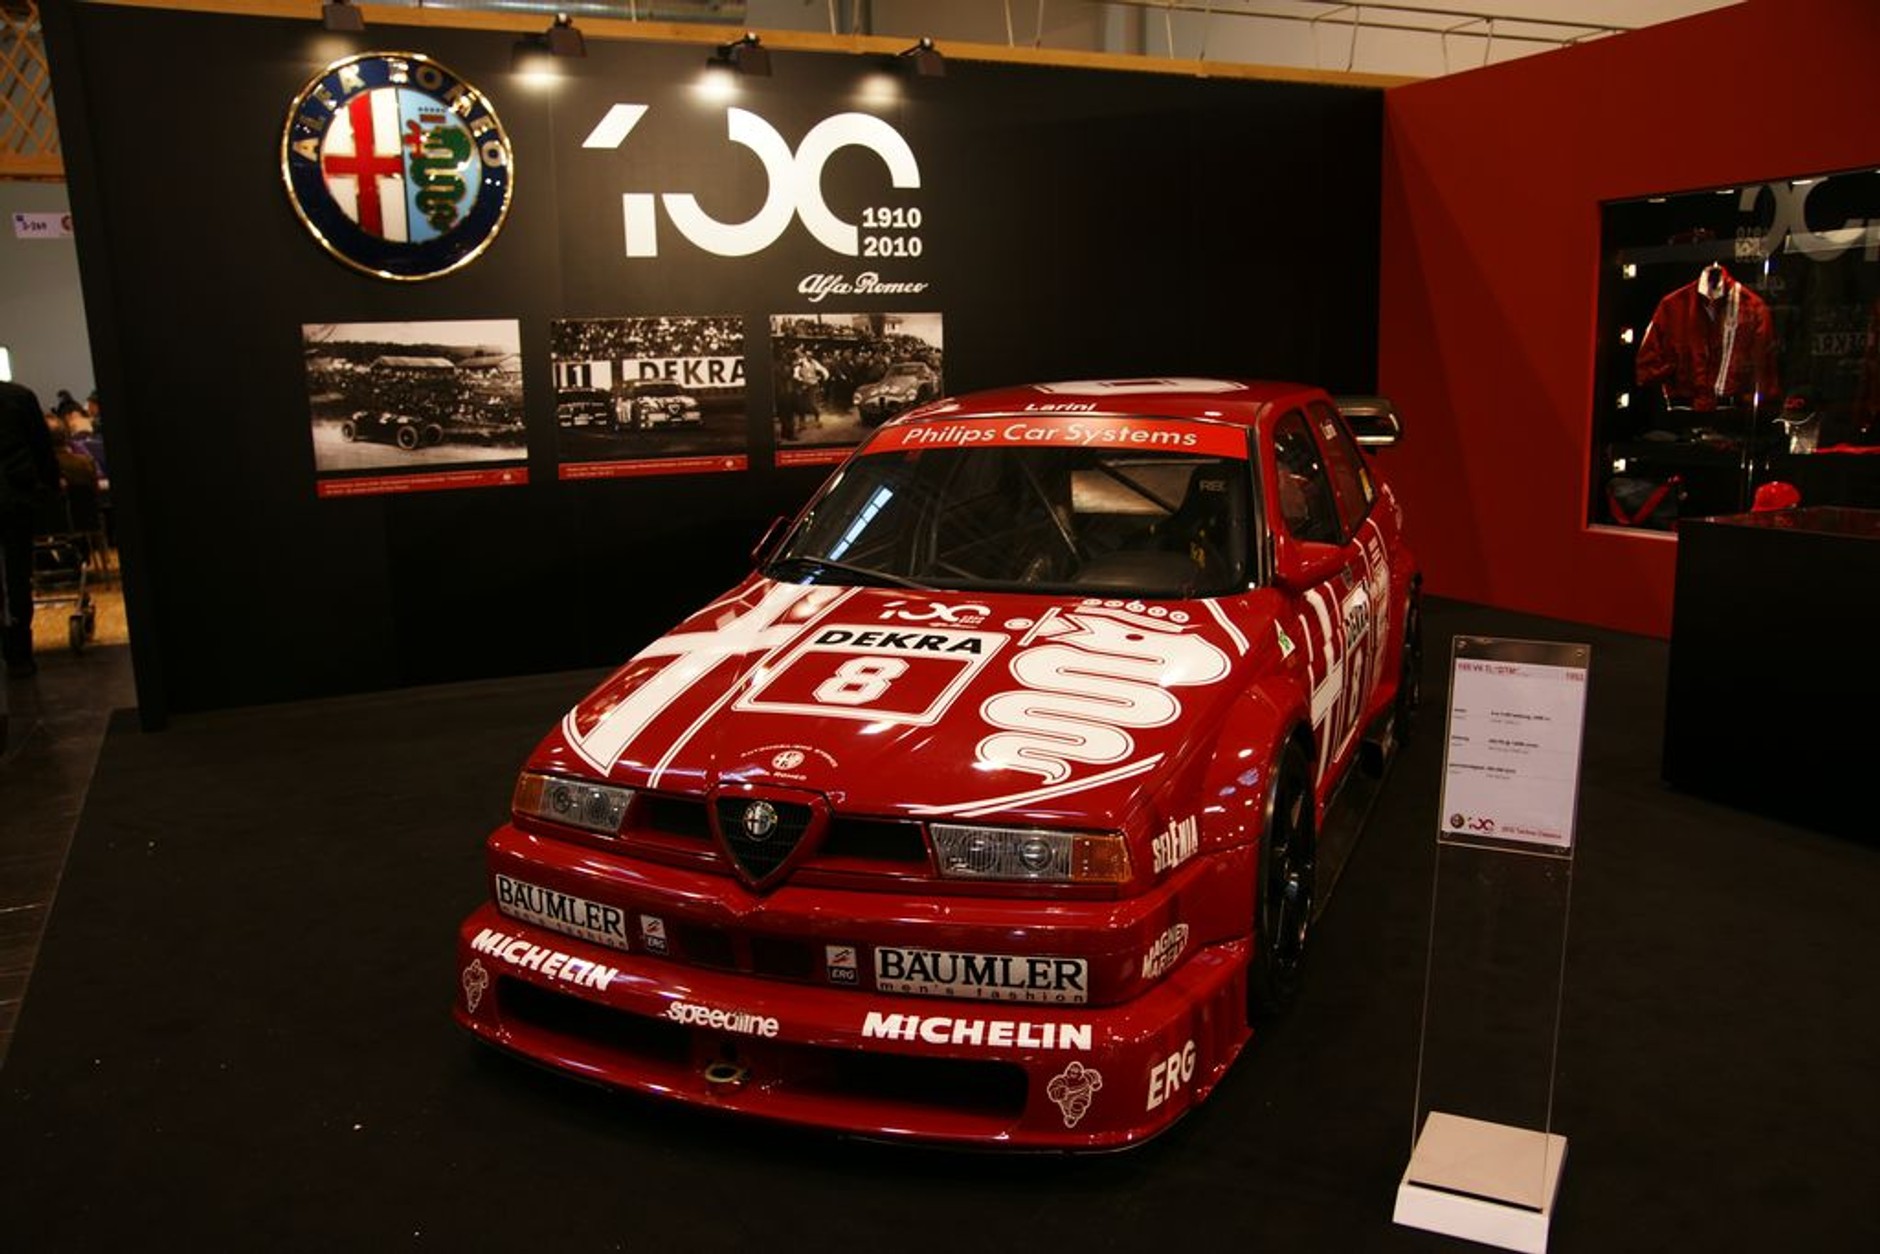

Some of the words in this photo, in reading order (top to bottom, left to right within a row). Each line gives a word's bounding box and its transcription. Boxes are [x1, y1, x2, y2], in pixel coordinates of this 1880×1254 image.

[292, 64, 367, 162] ALFA
[387, 58, 508, 168] ROMEO
[862, 207, 923, 229] 1910
[863, 236, 923, 257] 2010
[797, 272, 853, 303] Alfa
[853, 271, 929, 295] Romeo
[1024, 402, 1097, 412] Larini
[902, 423, 996, 445] Philips
[1003, 423, 1060, 442] Car
[1065, 423, 1198, 447] Systems
[814, 630, 982, 655] DEKRA
[811, 656, 910, 705] 8
[497, 876, 625, 938] BÄUMLER
[470, 927, 620, 991] MICHELIN
[831, 968, 856, 982] ERG
[878, 949, 1084, 991] BÄUMLER
[879, 982, 954, 995] men's
[975, 986, 1084, 1003] fashion
[862, 1011, 1093, 1051] MICHELIN
[1146, 1039, 1197, 1112] ERG
